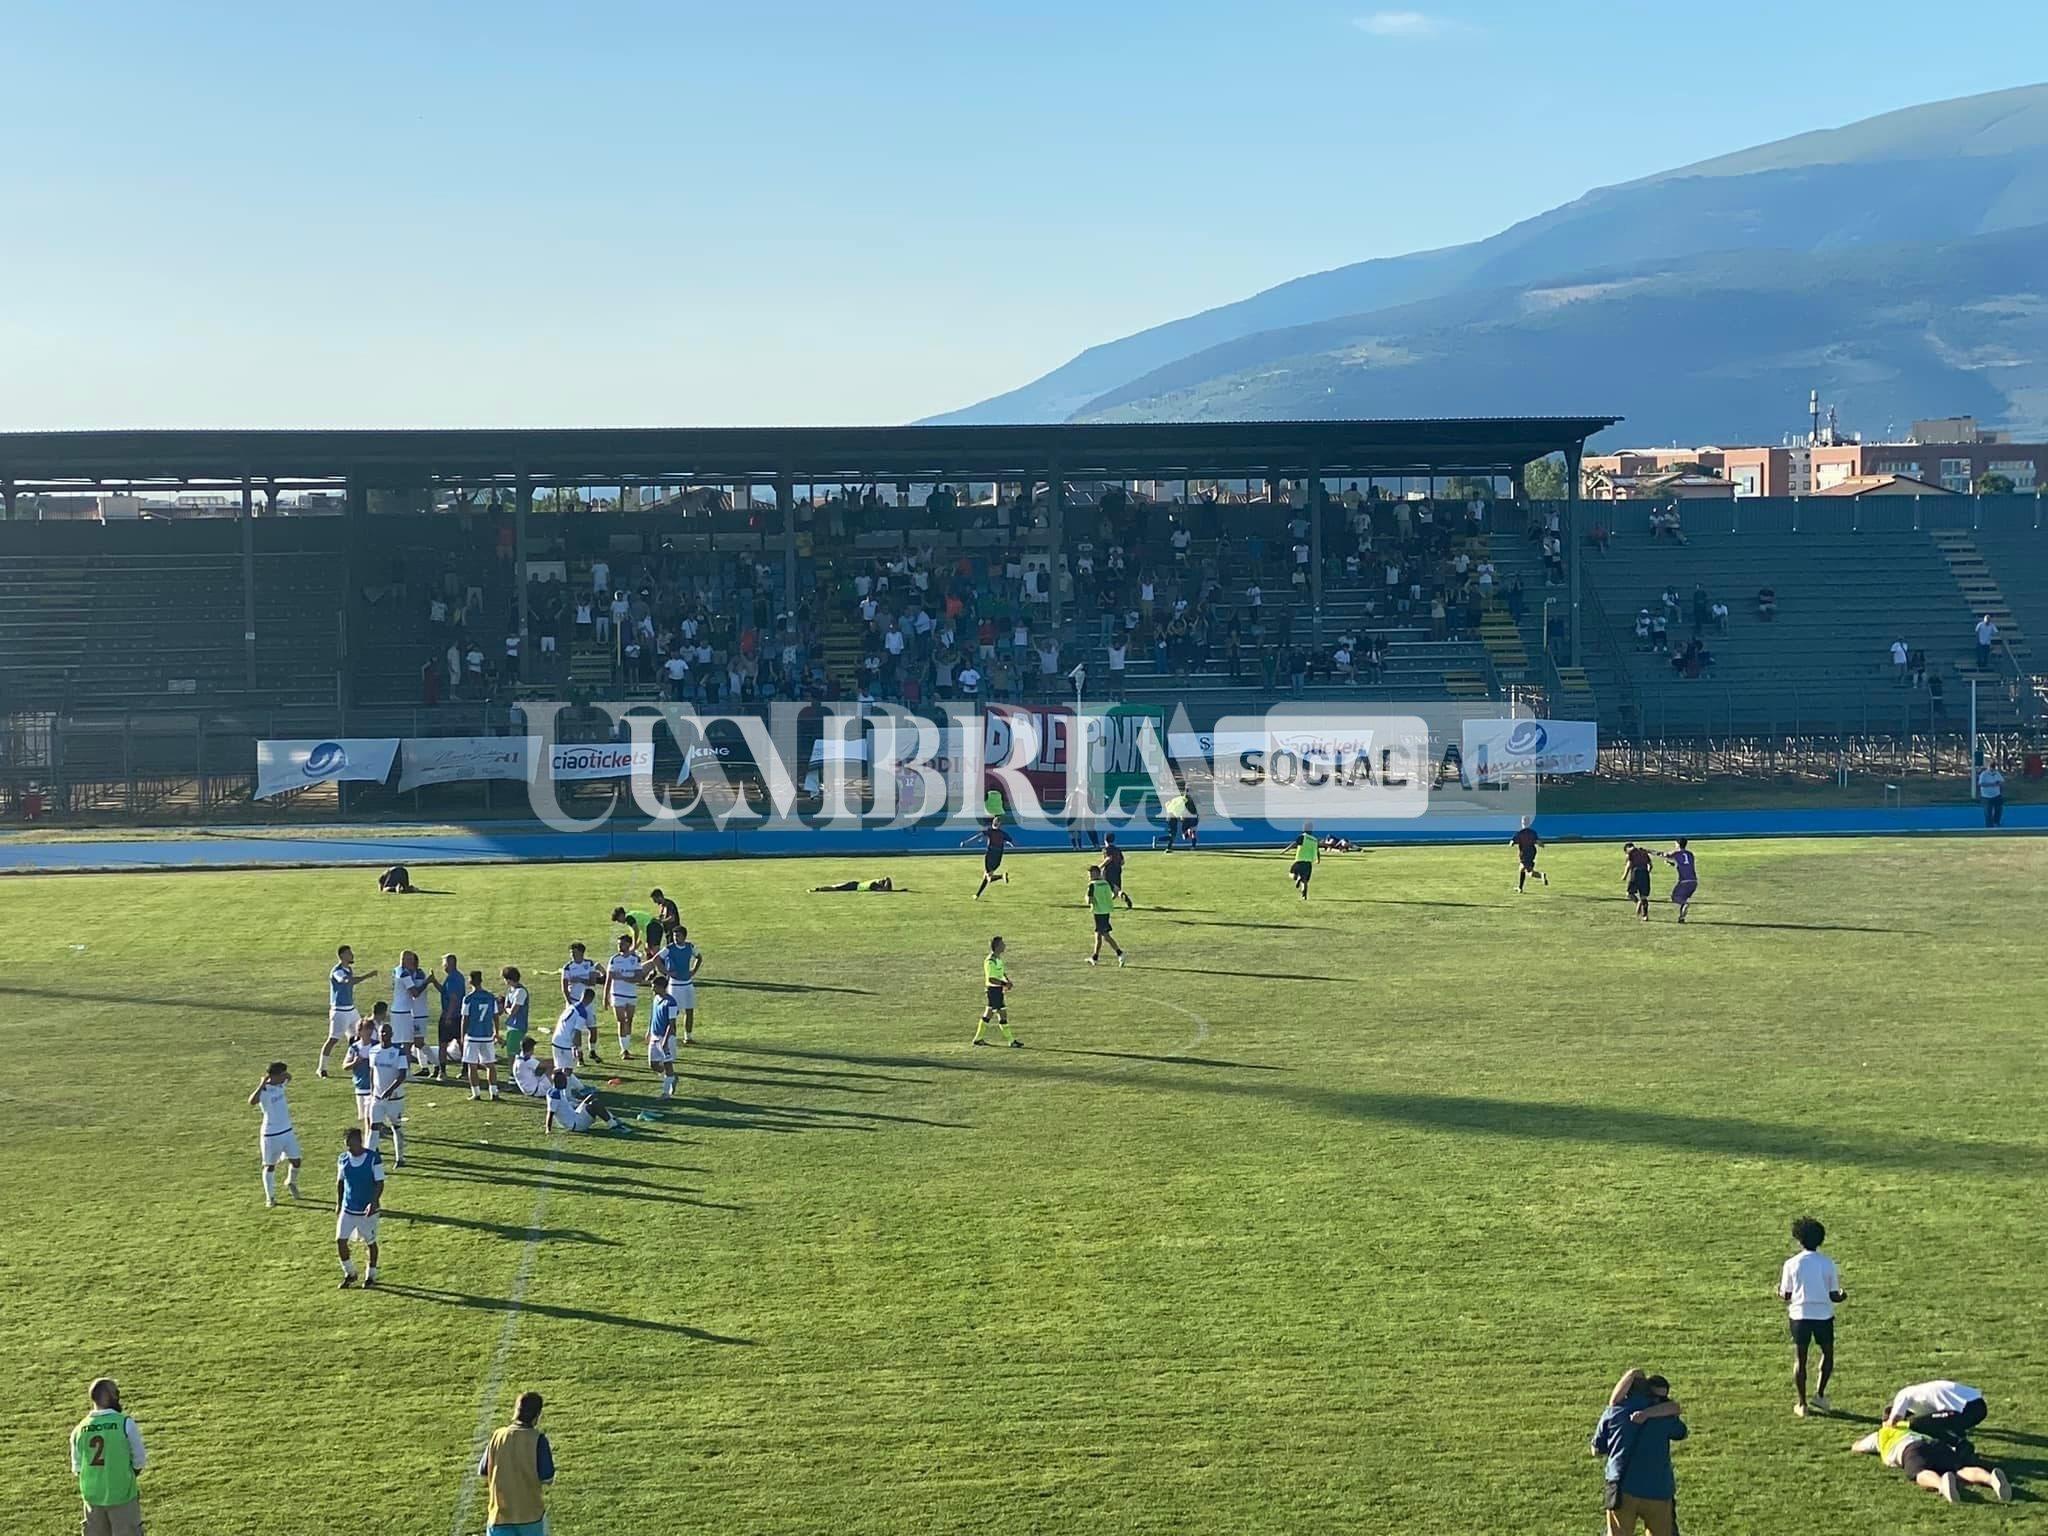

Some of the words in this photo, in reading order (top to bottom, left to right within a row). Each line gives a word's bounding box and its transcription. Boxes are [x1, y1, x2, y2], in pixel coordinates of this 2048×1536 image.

[985, 710, 1069, 772] DALE
[1081, 715, 1161, 774] PONTE
[552, 750, 648, 770] ciaotickets
[1682, 853, 1690, 864] 1
[478, 1003, 489, 1022] 7
[89, 1434, 105, 1466] 2
